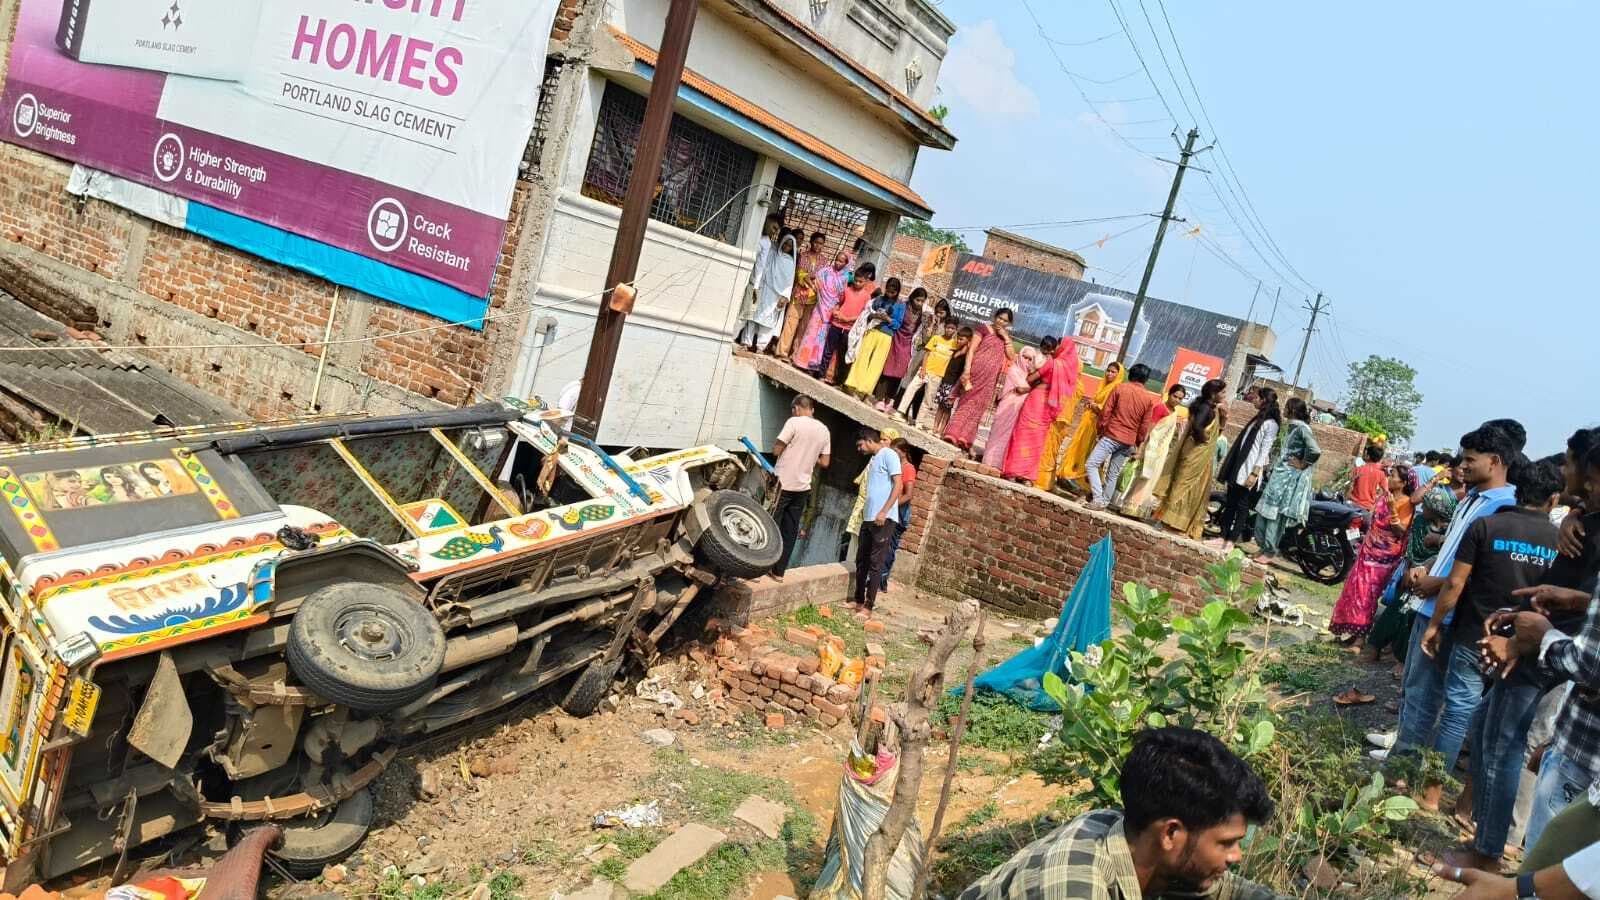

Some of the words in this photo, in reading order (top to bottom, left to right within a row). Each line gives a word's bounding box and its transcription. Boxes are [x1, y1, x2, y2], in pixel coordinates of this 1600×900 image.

[292, 15, 463, 96] HOMES
[39, 103, 72, 123] Superior
[282, 82, 351, 112] PORTLAND
[353, 100, 391, 122] SLAG
[393, 110, 456, 140] CEMENT
[35, 121, 77, 144] Brightness
[189, 146, 222, 168] Higher
[223, 157, 266, 182] Strength
[185, 167, 193, 182] &
[194, 170, 242, 199] Durability
[414, 215, 452, 240] Crack
[408, 236, 471, 271] Resistant
[961, 260, 994, 277] ACC
[952, 288, 987, 304] SHIELD
[988, 297, 1020, 312] FROM
[1183, 362, 1210, 375] ACC
